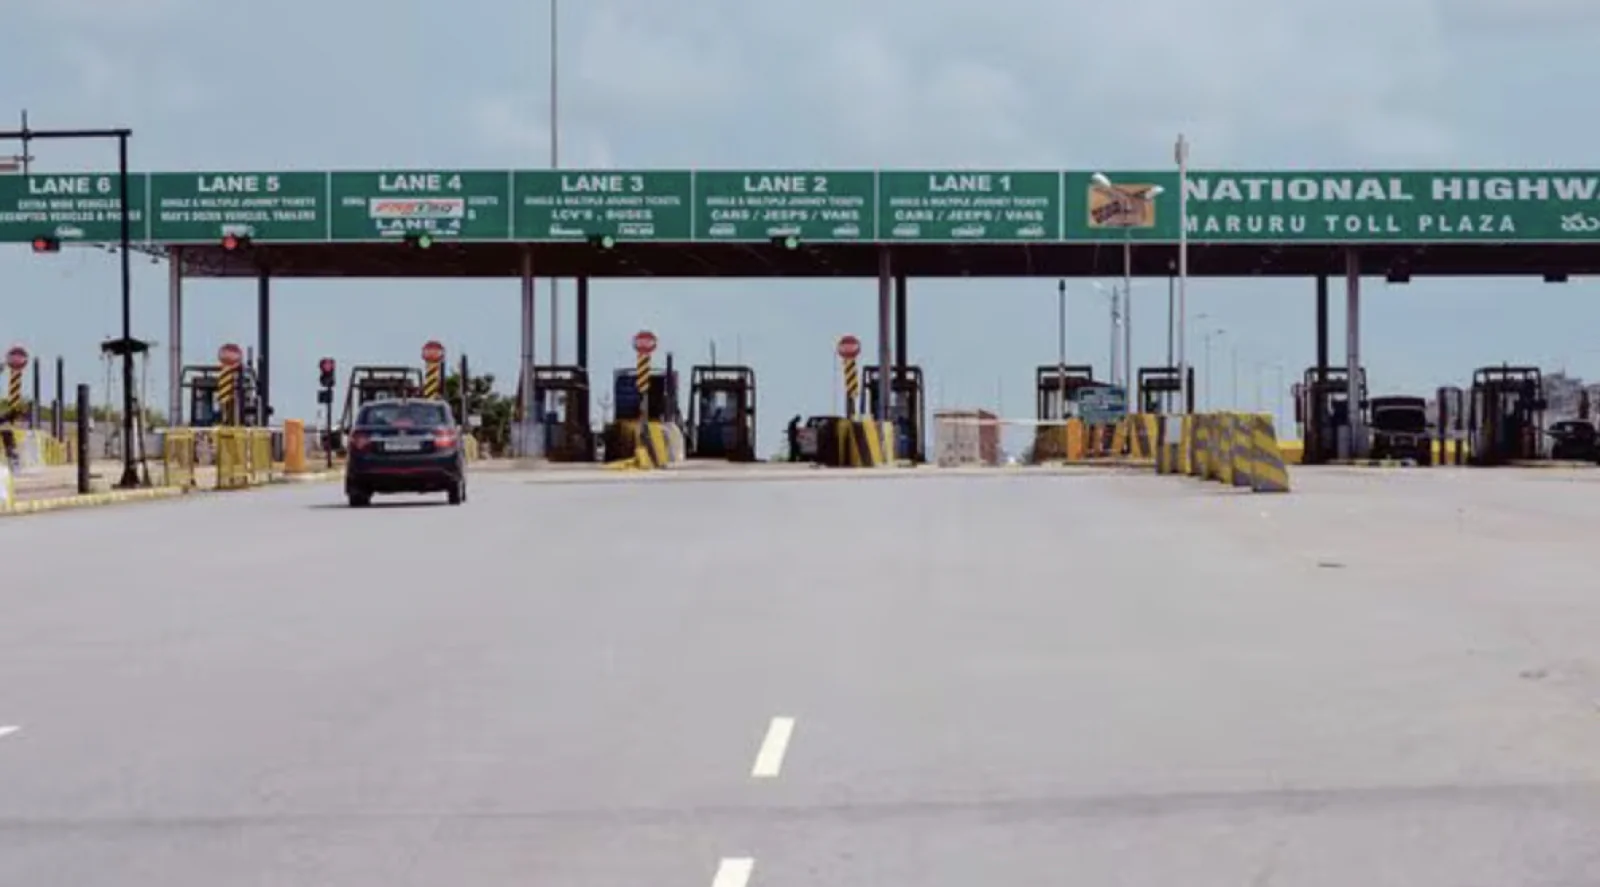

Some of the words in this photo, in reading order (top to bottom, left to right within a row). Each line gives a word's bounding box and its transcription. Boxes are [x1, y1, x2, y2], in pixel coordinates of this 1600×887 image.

[29, 177, 90, 193] LANE
[97, 177, 110, 193] 6
[198, 176, 258, 191] LANE
[266, 176, 280, 191] 5
[380, 174, 440, 190] LANE
[447, 175, 462, 190] 4
[561, 175, 623, 191] LANE
[630, 176, 643, 191] 3
[744, 176, 806, 192] LANE
[814, 177, 828, 192] 2
[929, 175, 991, 191] LANE
[1000, 175, 1011, 191] 1
[1185, 178, 1413, 200] NATIONAL
[1431, 178, 1600, 200] HIGHW
[711, 210, 749, 221] CARS
[763, 210, 808, 221] JEEPS
[821, 210, 859, 221] VANS
[895, 210, 933, 221] CARS
[947, 210, 992, 221] JEEPS
[1005, 210, 1044, 221] VANS
[1185, 216, 1305, 232] MARURU
[1326, 216, 1400, 232] TOLL
[1419, 215, 1515, 232] PLAZA
[376, 219, 437, 231] LANE
[447, 219, 461, 231] 4
